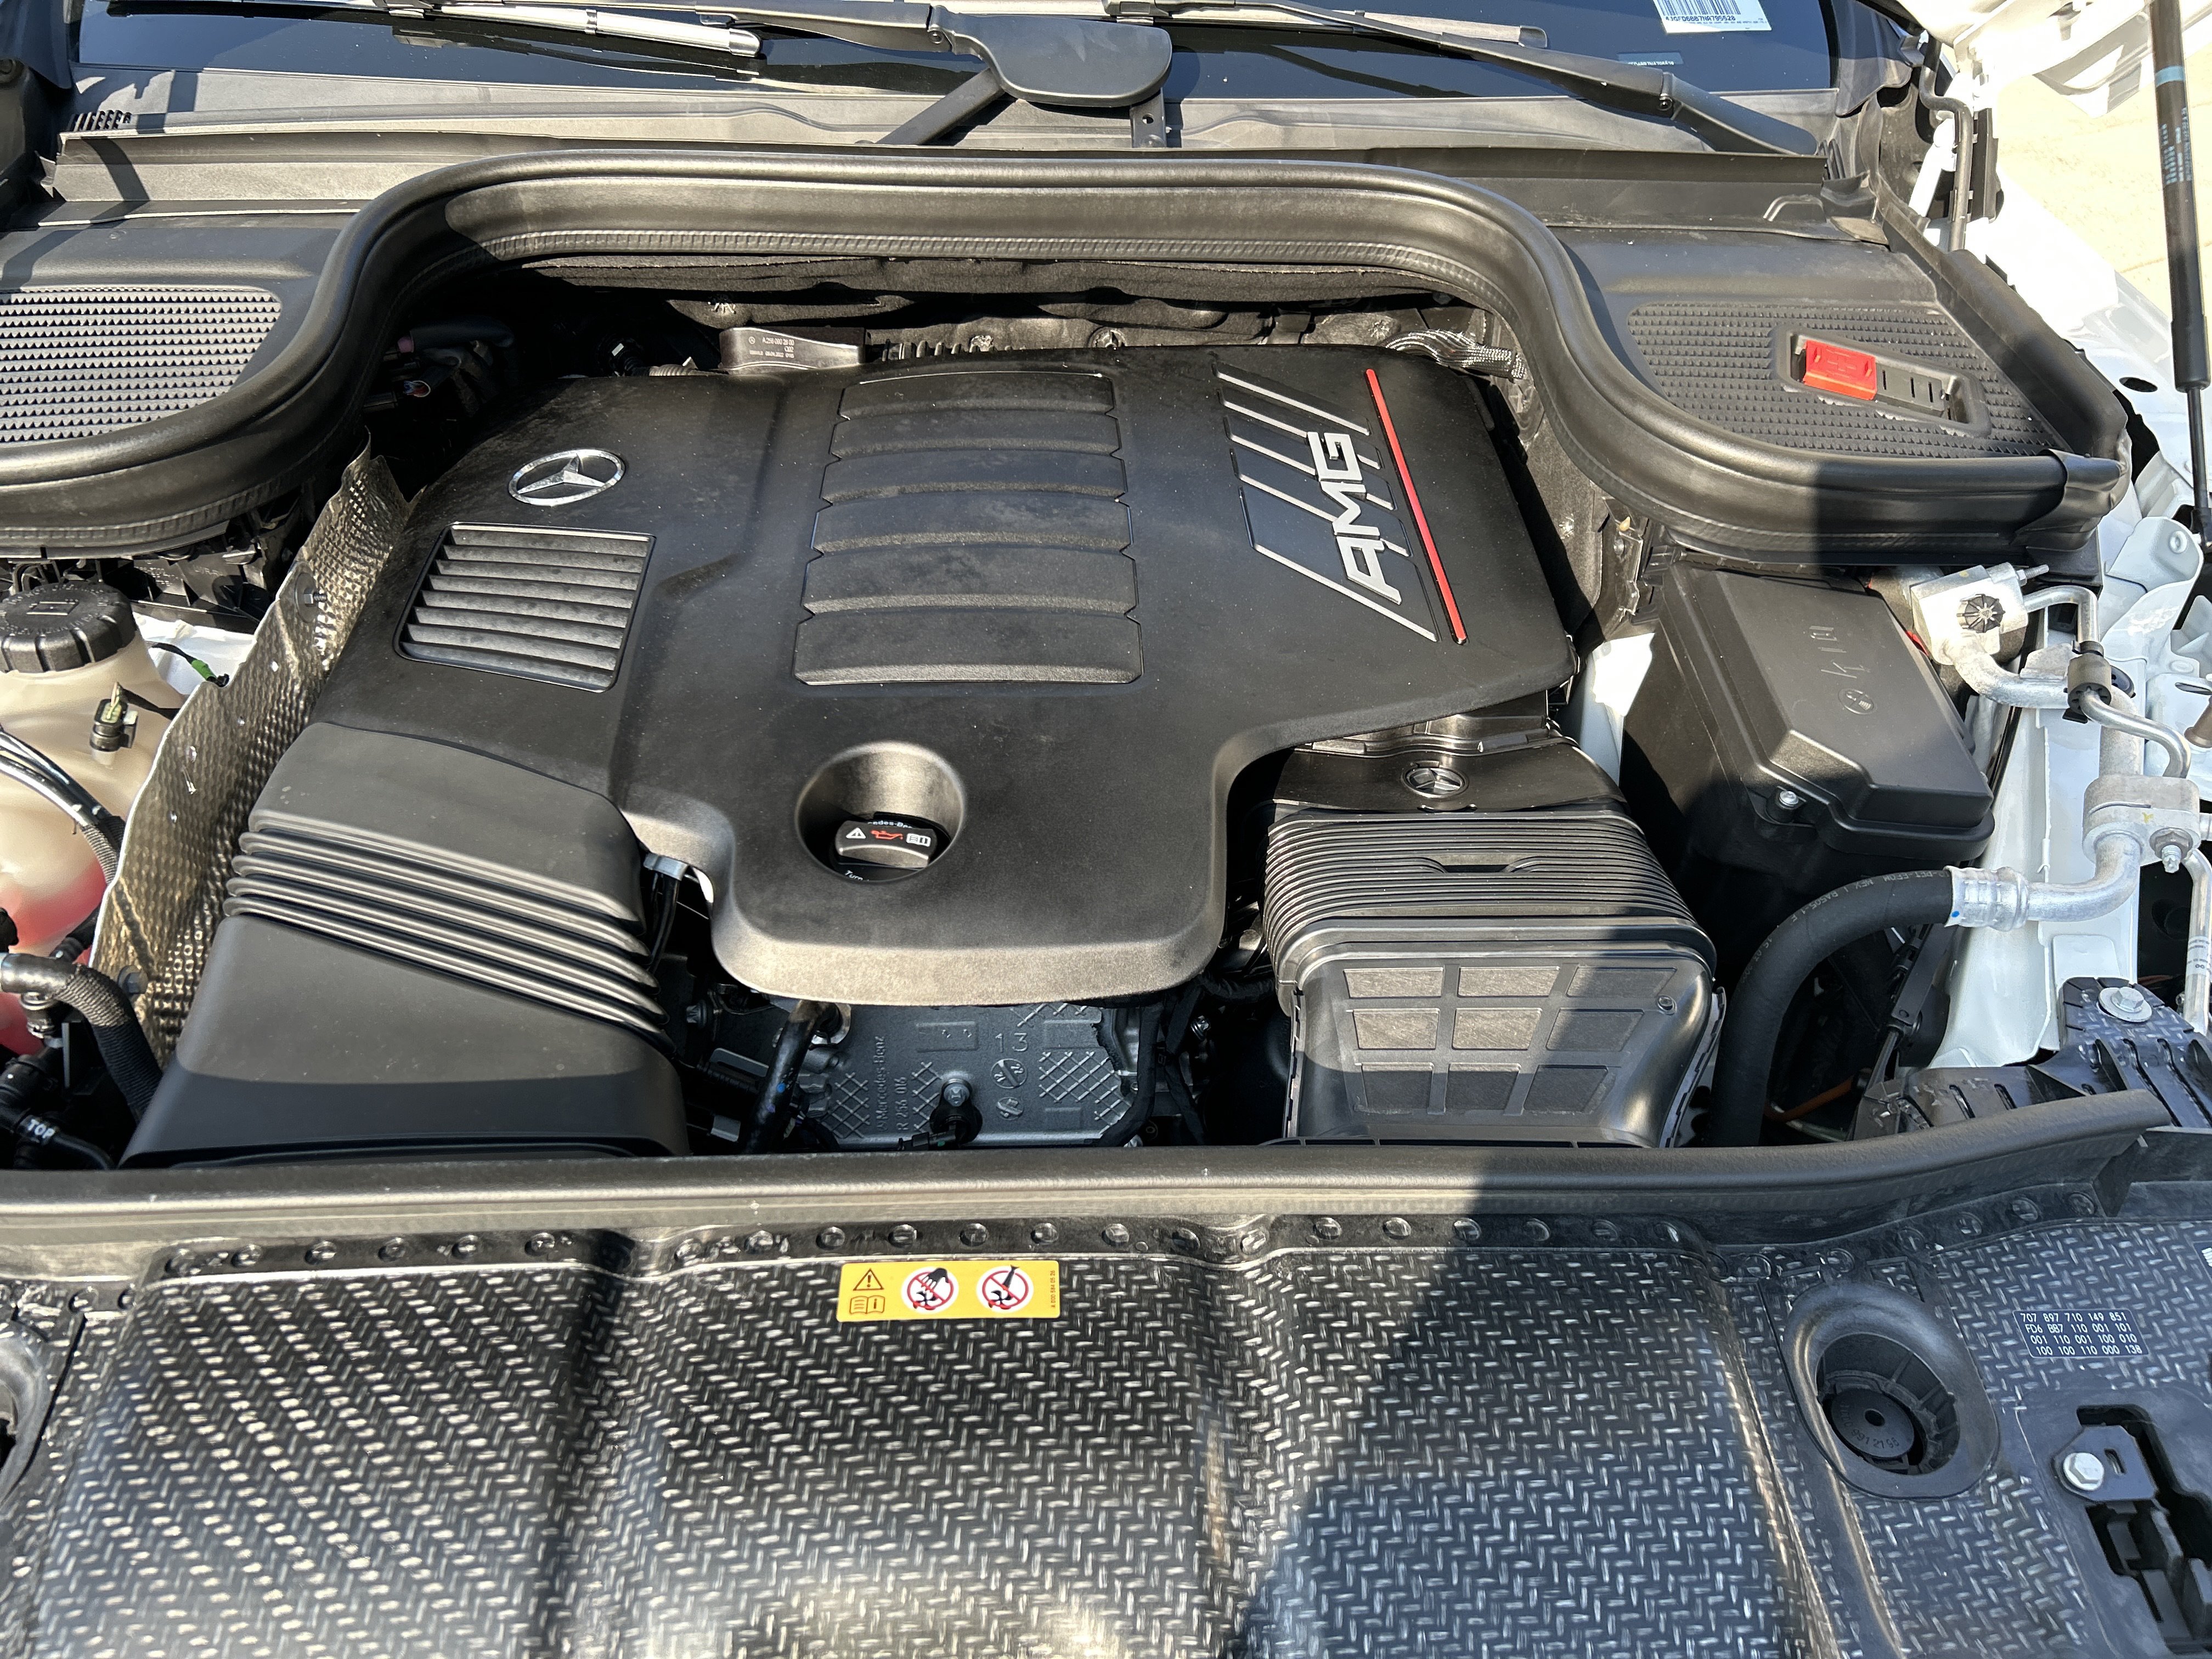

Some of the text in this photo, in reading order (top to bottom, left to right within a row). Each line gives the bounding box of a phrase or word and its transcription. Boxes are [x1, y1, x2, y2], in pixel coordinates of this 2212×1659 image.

[1307, 432, 1401, 605] AMG
[873, 1036, 888, 1120] Mercedes-Benz
[28, 1119, 55, 1139] TOP
[2020, 1312, 2127, 1322] 707 897 710 149 851
[2025, 1324, 2043, 1333] FD6
[2071, 1323, 2087, 1333] 110
[2092, 1323, 2109, 1333] 001
[2115, 1323, 2131, 1332] 101
[2030, 1334, 2137, 1344] 001 110 001 100 010
[2036, 1346, 2053, 1356] 100
[2058, 1346, 2075, 1355] 100
[2080, 1346, 2097, 1355] 110
[2102, 1345, 2120, 1355] 000
